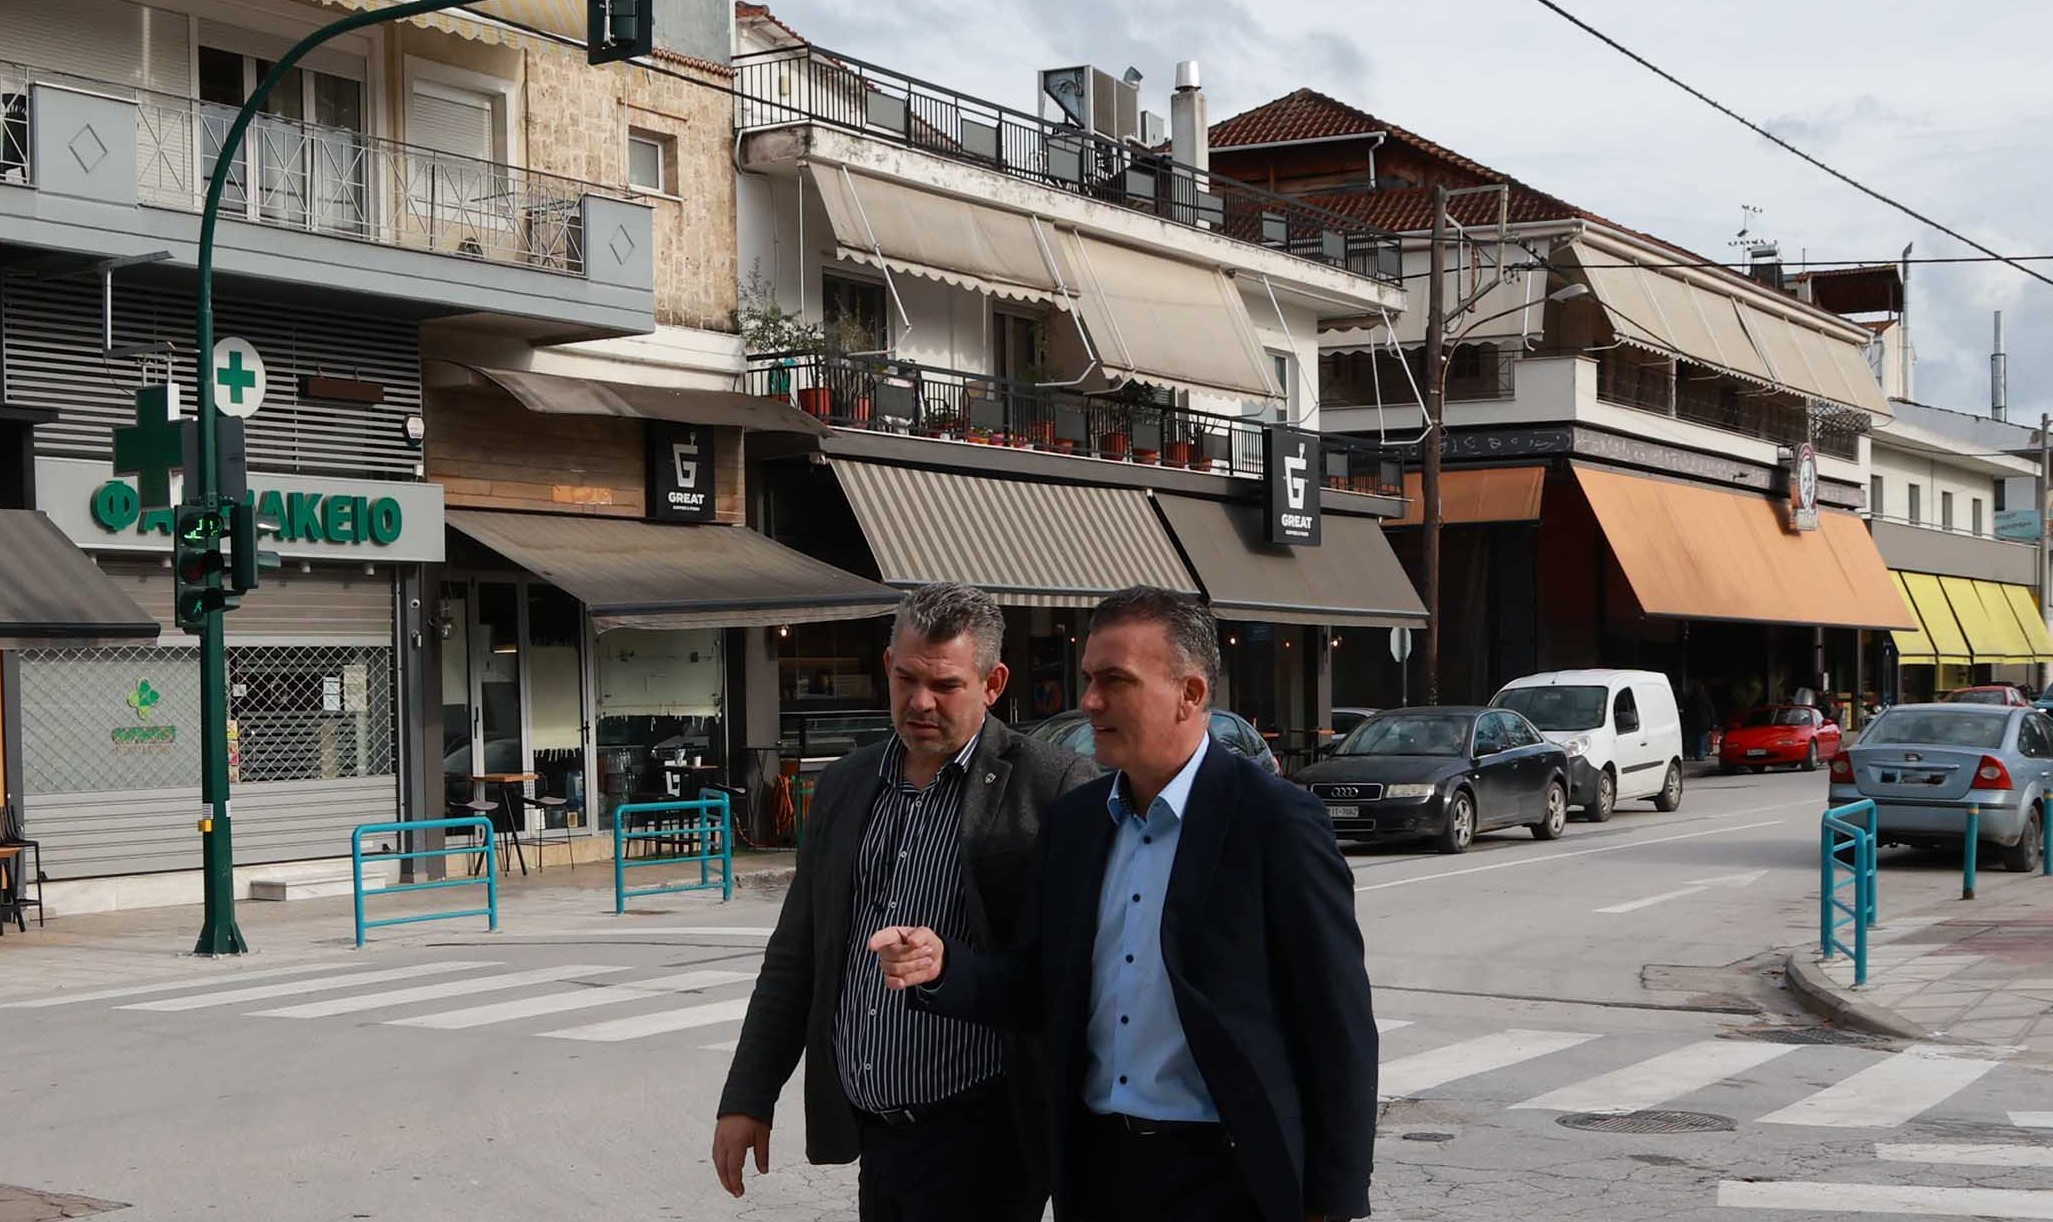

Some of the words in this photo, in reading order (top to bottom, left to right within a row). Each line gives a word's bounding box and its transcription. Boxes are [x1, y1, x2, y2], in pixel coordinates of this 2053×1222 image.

[668, 491, 705, 505] GREAT
[91, 480, 402, 545] ΦΑΚΕΙΟ
[1281, 513, 1313, 529] GREAT
